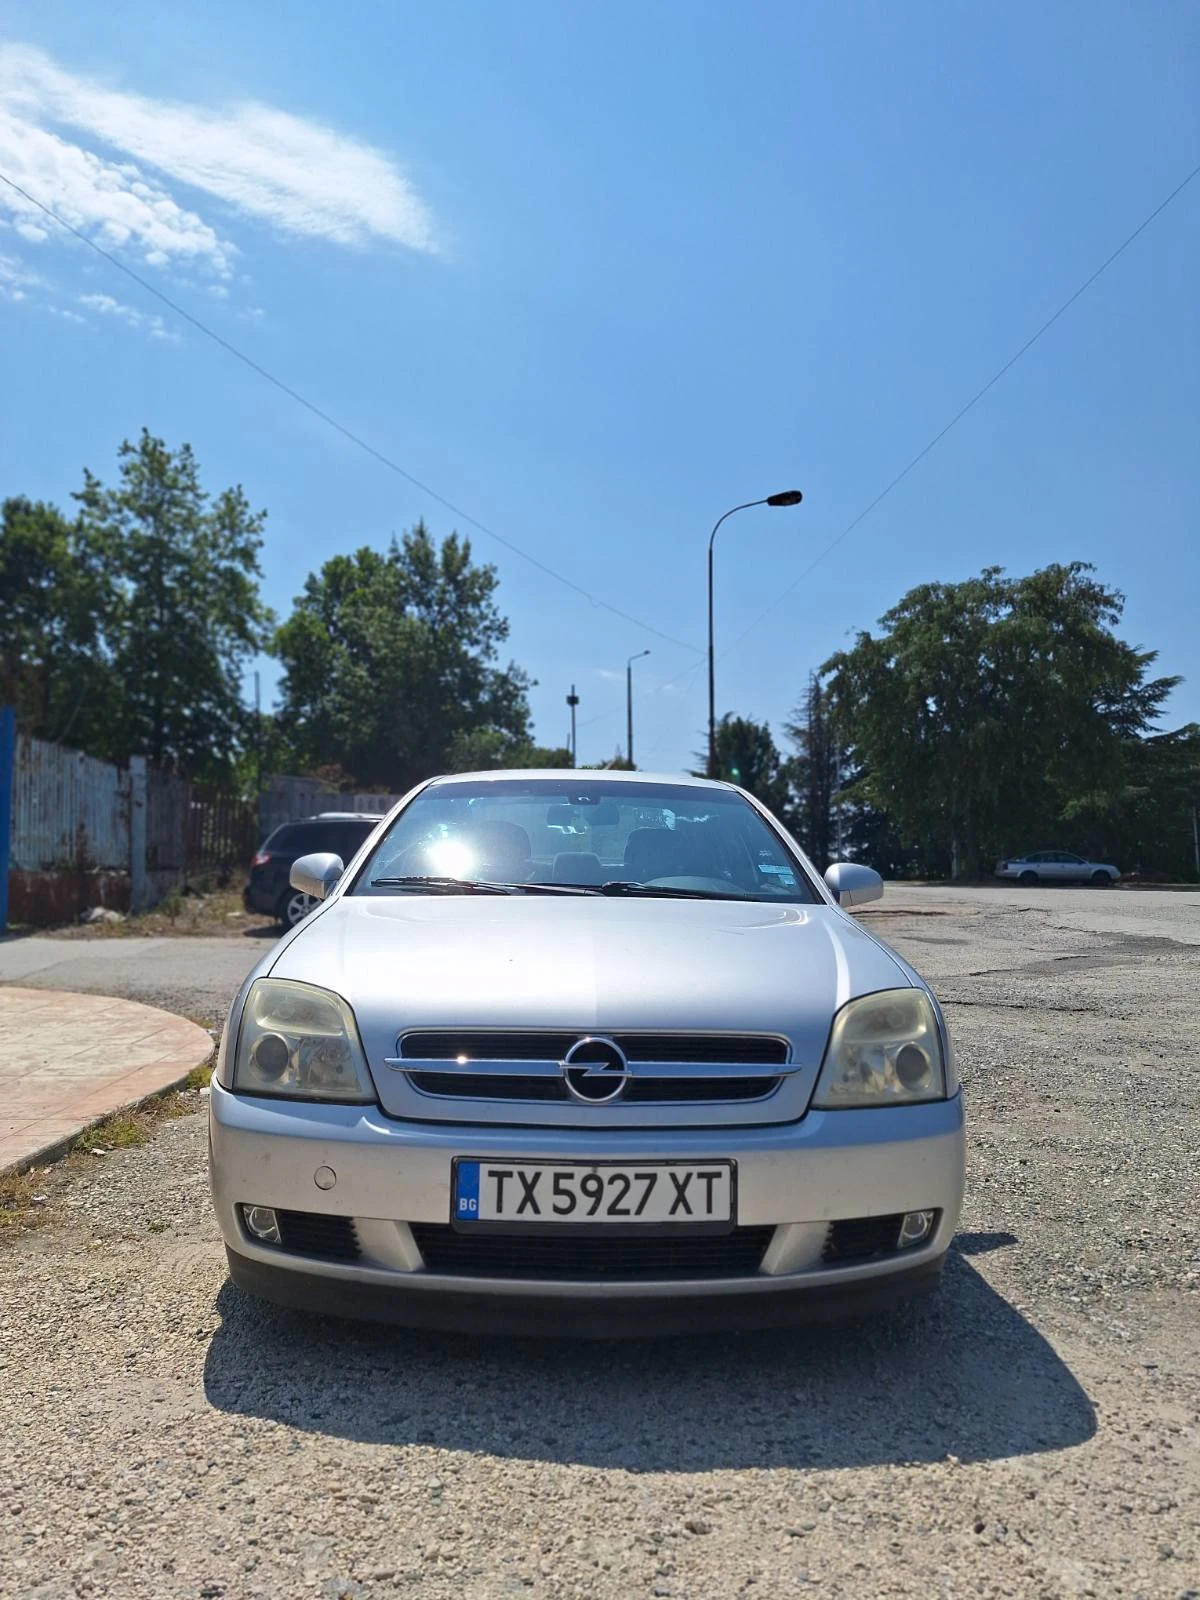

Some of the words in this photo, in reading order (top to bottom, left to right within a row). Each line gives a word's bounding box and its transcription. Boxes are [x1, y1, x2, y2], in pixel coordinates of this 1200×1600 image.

[459, 1198, 477, 1211] BG
[488, 1170, 541, 1215] TX
[552, 1172, 658, 1216] 5927
[668, 1171, 722, 1215] XT
